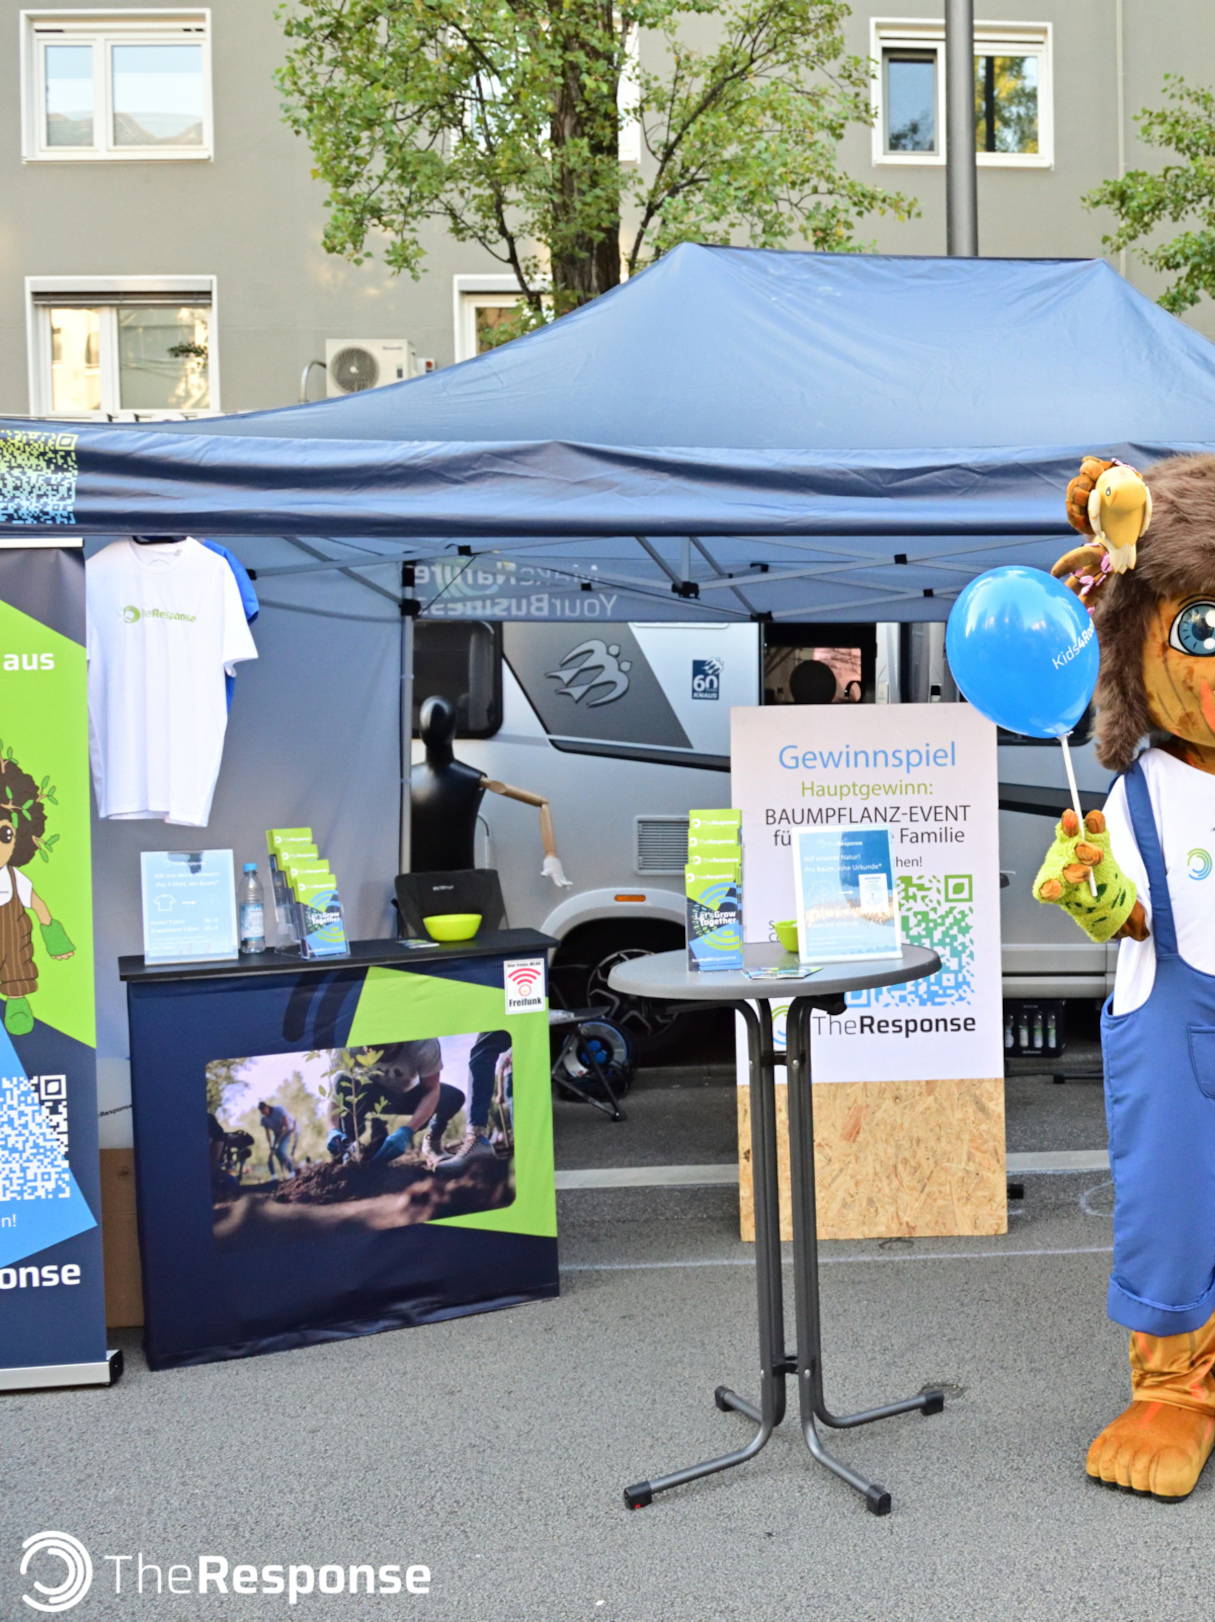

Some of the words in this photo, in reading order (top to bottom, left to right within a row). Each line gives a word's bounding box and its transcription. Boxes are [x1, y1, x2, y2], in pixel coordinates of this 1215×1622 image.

[3, 652, 55, 671] aus
[693, 674, 718, 692] 60
[779, 741, 955, 773] Gewinnspiel
[801, 780, 933, 800] Hauptgewinn:
[765, 805, 971, 825] BAUMPFLANZ-EVENT
[773, 829, 791, 846] fü
[900, 827, 965, 844] Familie
[895, 856, 923, 867] hen!
[509, 996, 542, 1007] Freifunk
[812, 1014, 976, 1038] TheResponse
[99, 1104, 132, 1117] Response
[1, 1213, 16, 1228] n!
[0, 1263, 81, 1289] onse
